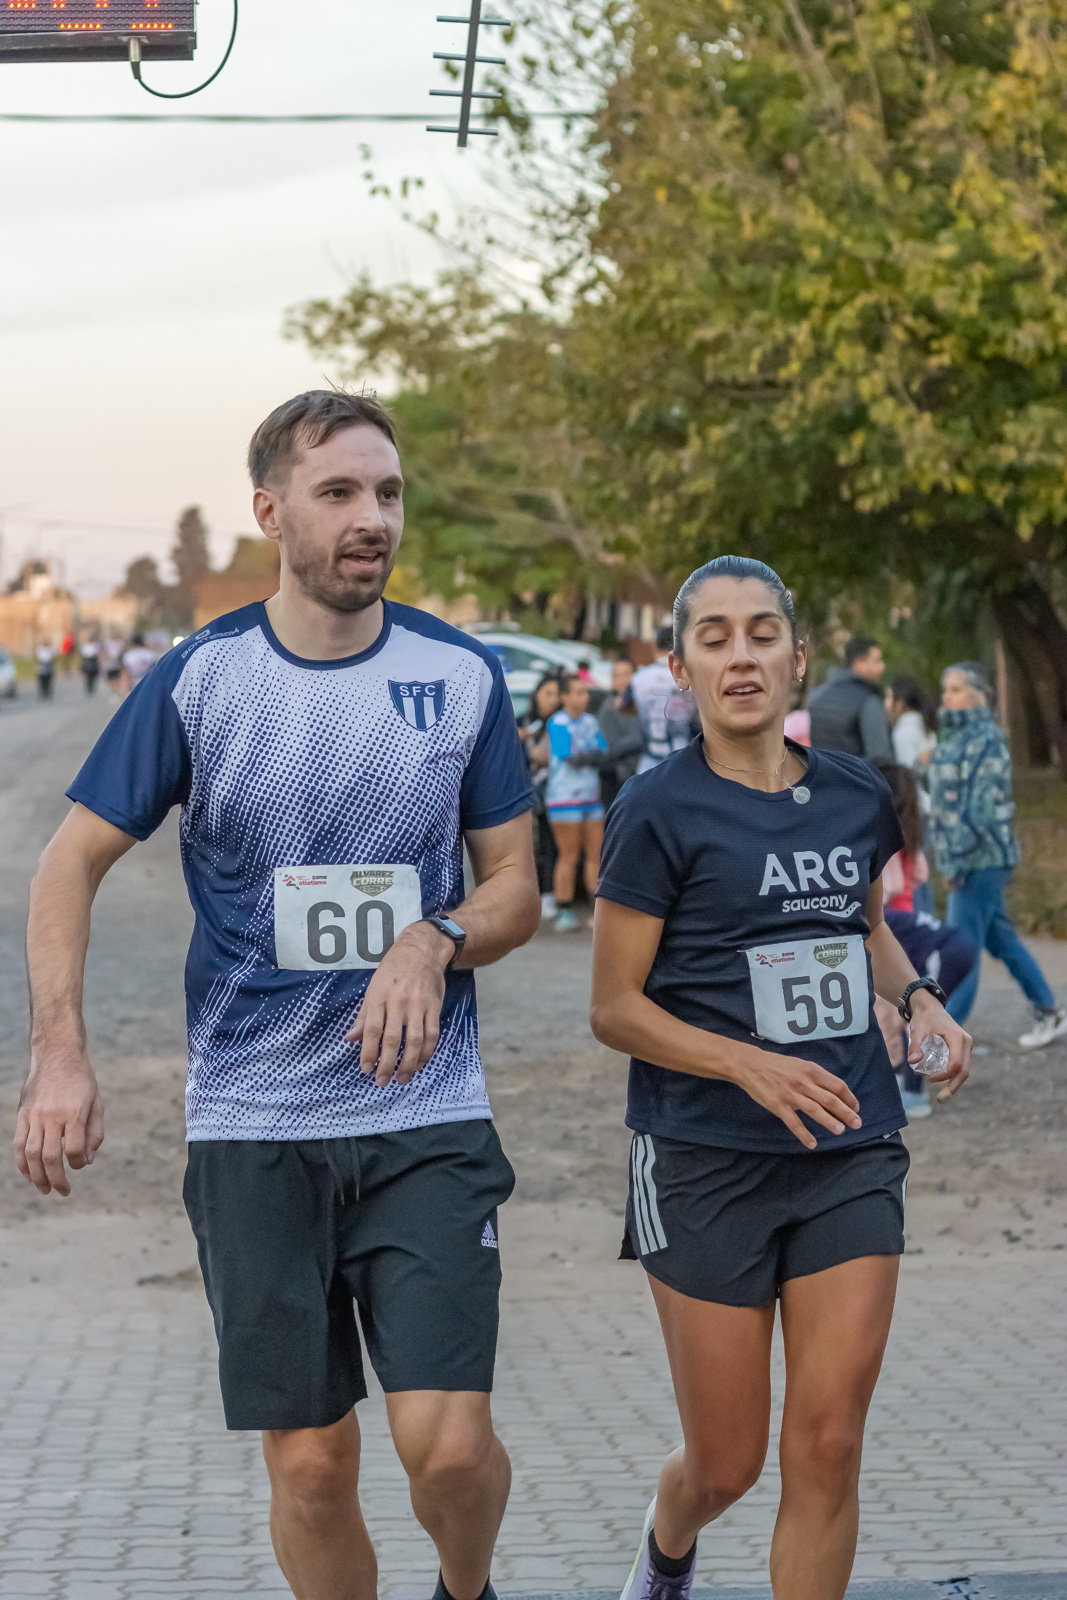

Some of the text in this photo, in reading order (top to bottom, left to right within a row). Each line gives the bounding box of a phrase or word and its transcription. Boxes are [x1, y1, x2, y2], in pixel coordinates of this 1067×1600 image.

[399, 684, 436, 697] SFC
[758, 845, 860, 896] ARG
[352, 877, 393, 885] CORRE
[781, 894, 848, 913] saucony
[306, 899, 395, 965] 60
[814, 942, 849, 952] ALVAREZ
[816, 949, 849, 960] CORRE
[781, 971, 854, 1036] 59
[480, 1239, 497, 1249] adida
